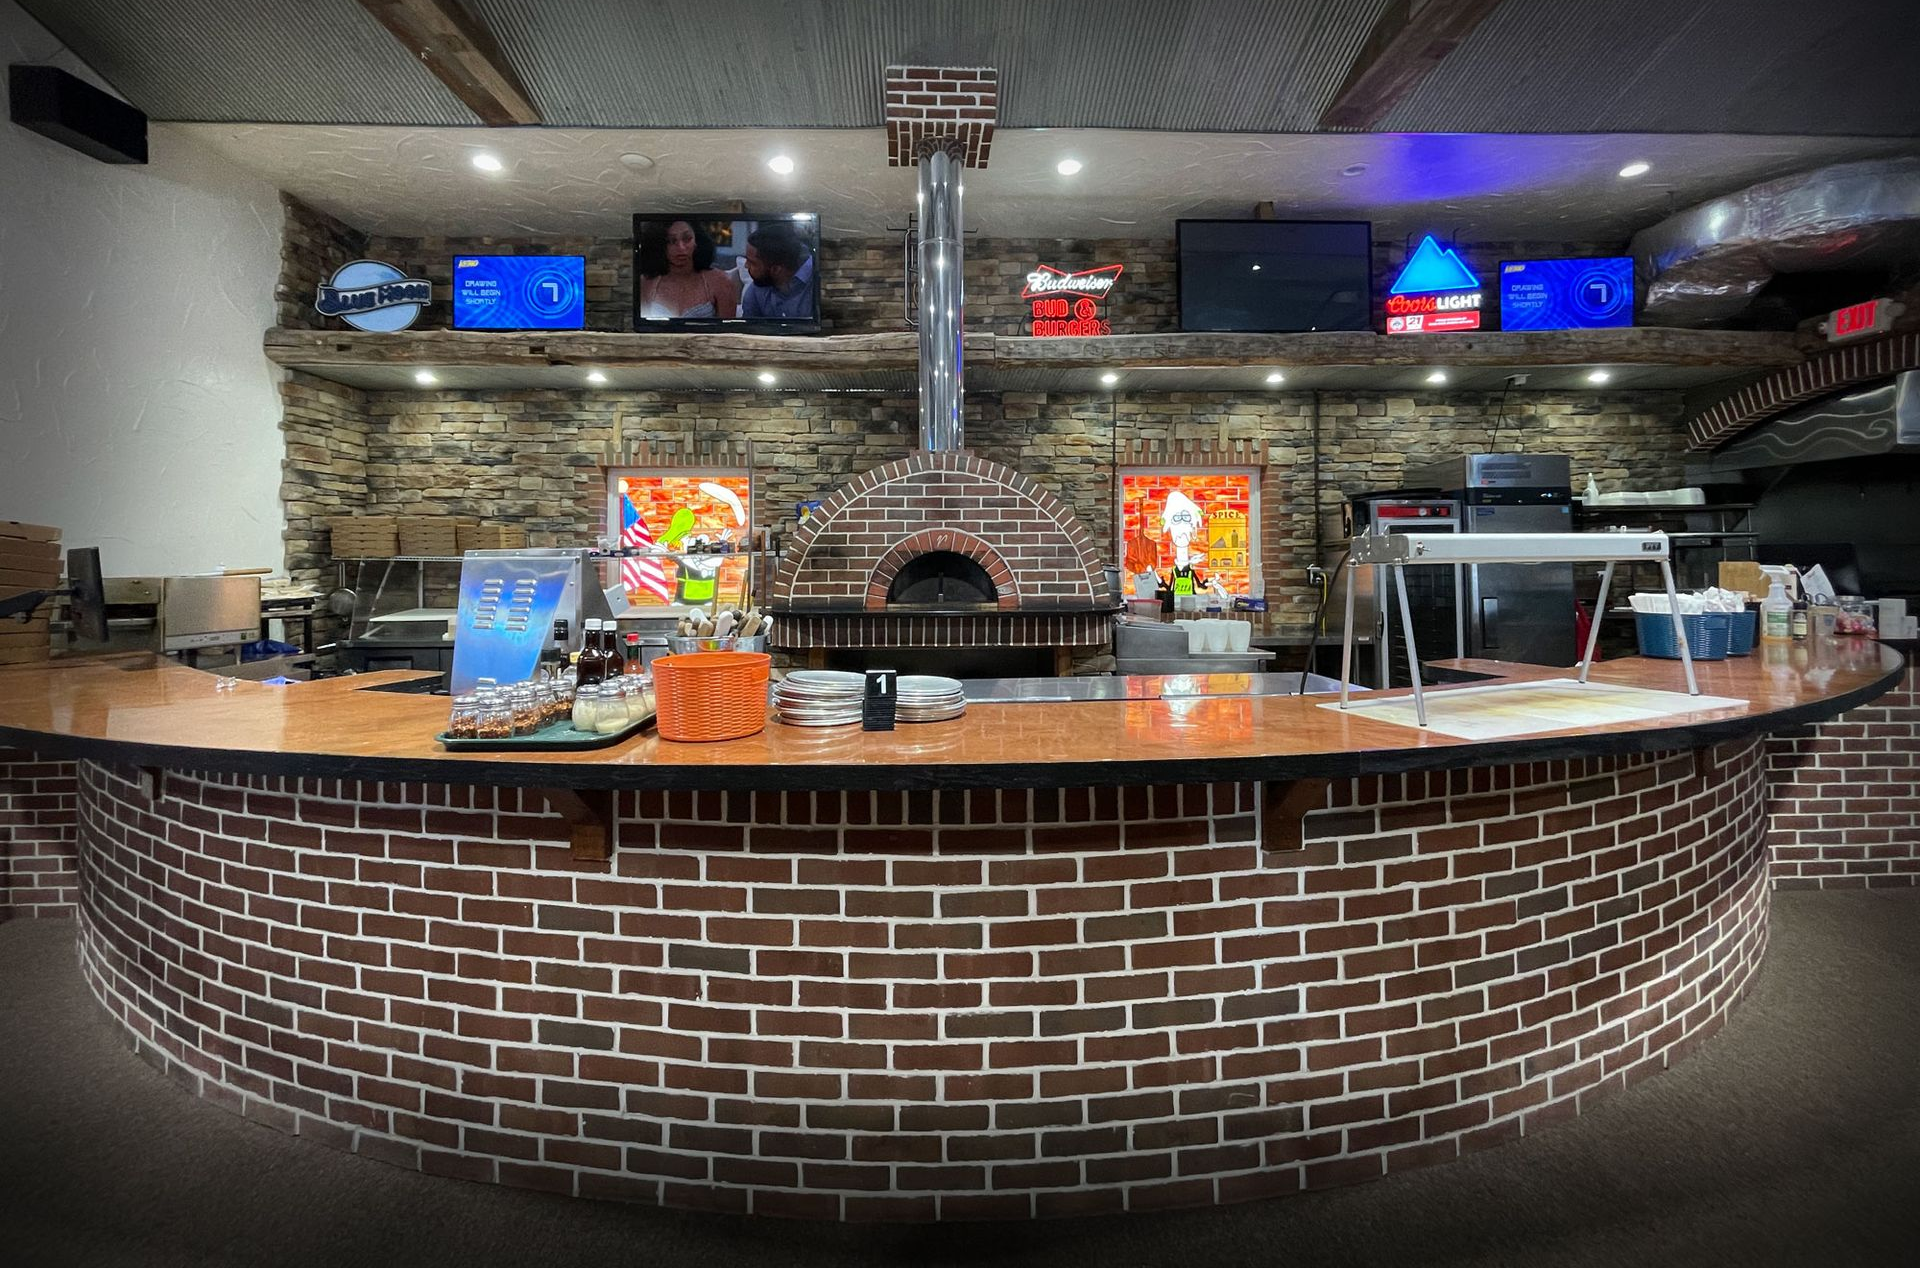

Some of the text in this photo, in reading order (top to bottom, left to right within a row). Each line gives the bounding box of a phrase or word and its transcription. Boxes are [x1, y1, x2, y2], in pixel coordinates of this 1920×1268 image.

[1027, 272, 1113, 292] Budweiser
[1033, 298, 1069, 318] BUD
[1387, 293, 1481, 313] Coors LIGHT
[1836, 300, 1878, 335] EXIT
[1033, 320, 1111, 337] BURGERS
[876, 674, 887, 694] 1
